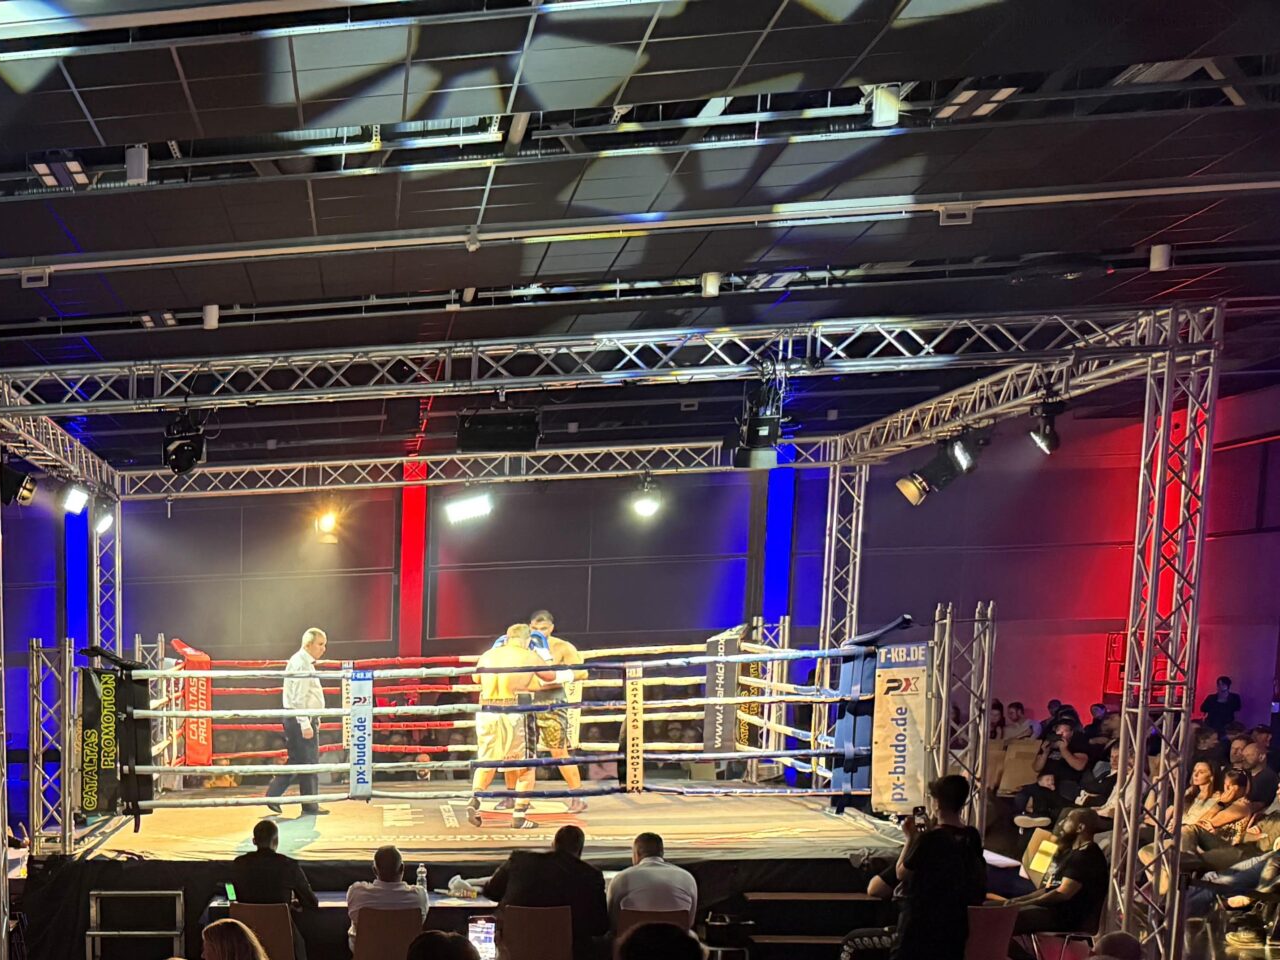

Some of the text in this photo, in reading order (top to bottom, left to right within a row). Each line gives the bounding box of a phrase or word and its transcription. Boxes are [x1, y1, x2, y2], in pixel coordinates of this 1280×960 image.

[879, 646, 926, 663] T-KB.DE
[100, 673, 116, 769] PROMOTION
[189, 678, 198, 740] CATLTAS
[198, 678, 208, 745] PROOTIO
[630, 681, 639, 730] CATALTAS
[83, 729, 99, 811] CATALTAS
[353, 716, 369, 785] px-budo.de
[888, 706, 908, 803] px-budo.de
